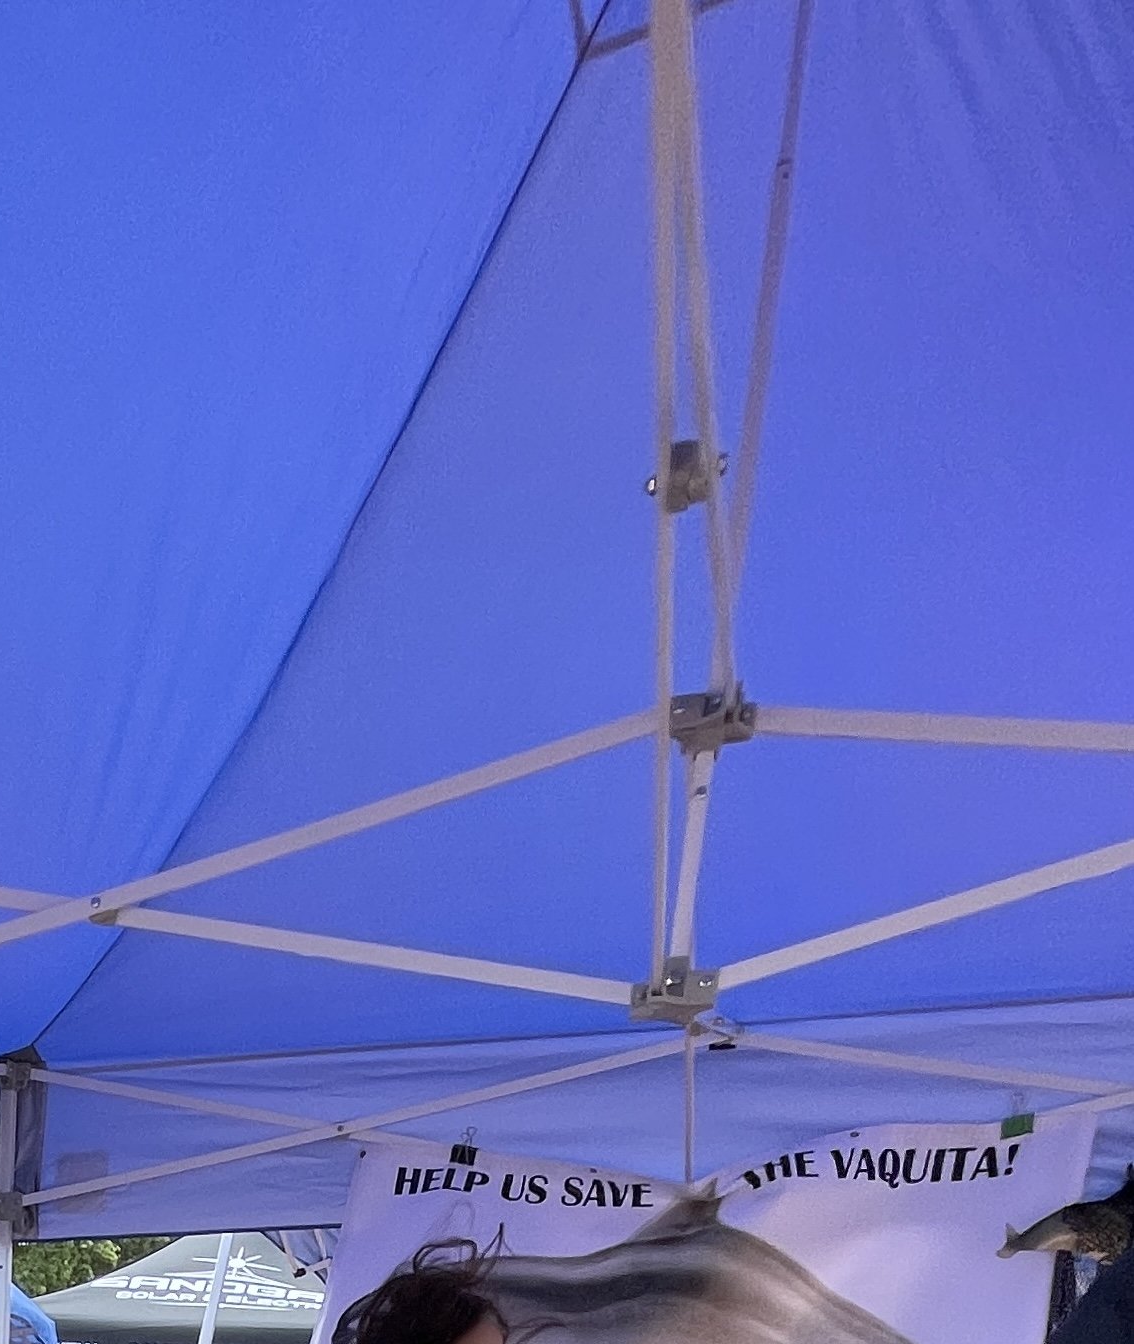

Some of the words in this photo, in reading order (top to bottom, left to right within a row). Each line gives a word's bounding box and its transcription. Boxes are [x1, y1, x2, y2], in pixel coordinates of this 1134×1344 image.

[394, 1166, 490, 1196] HELP
[501, 1174, 547, 1204] US
[561, 1176, 654, 1208] SAVE
[830, 1143, 1020, 1189] VAQUITA!
[90, 1275, 325, 1303] SANDBA
[115, 1290, 197, 1302] SOLAR
[226, 1294, 323, 1310] ELECTR
